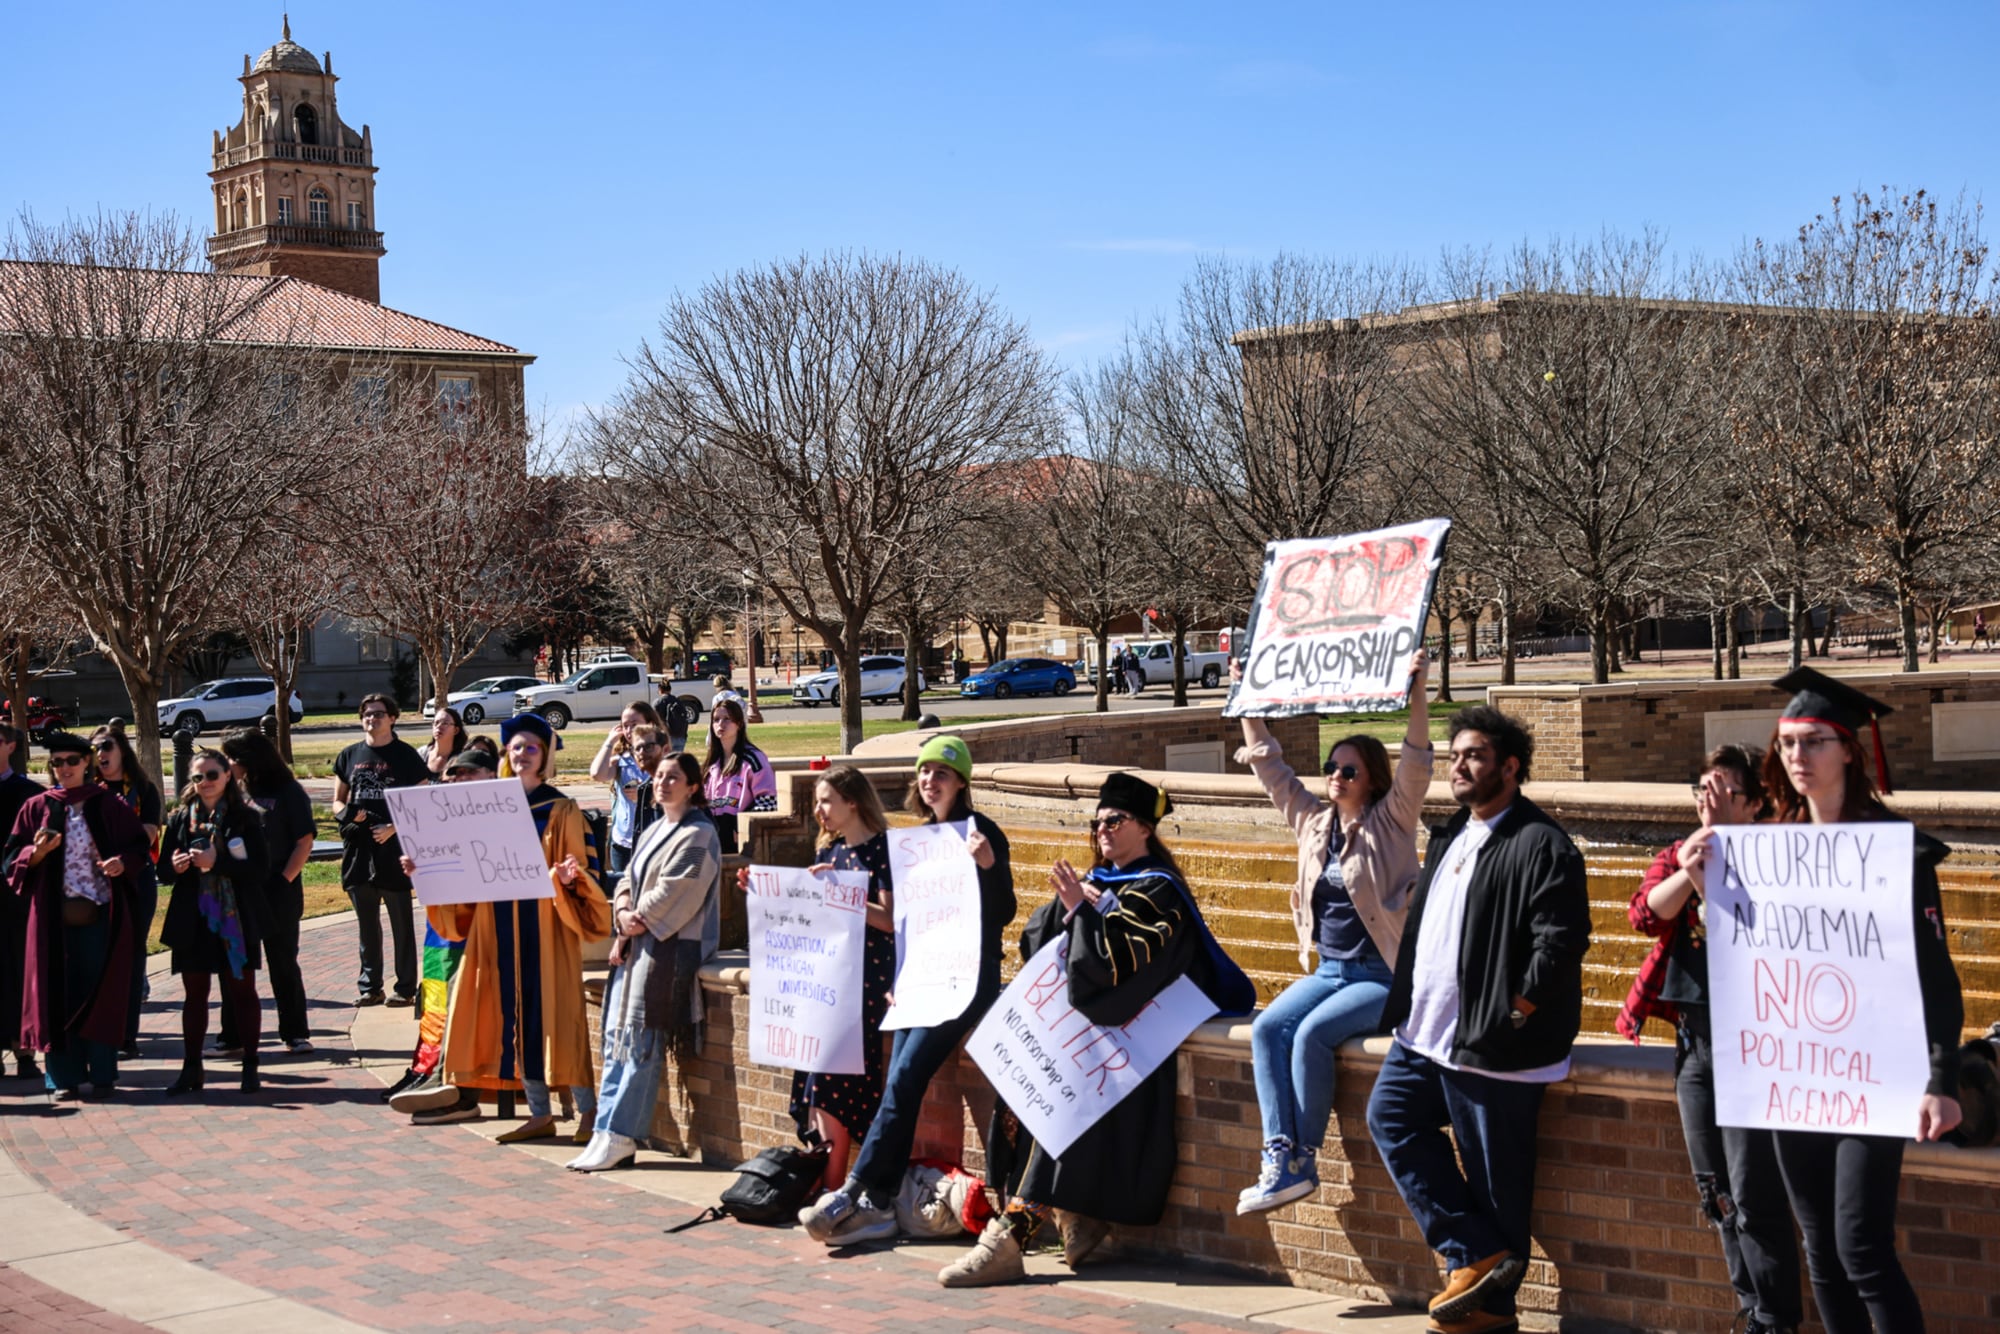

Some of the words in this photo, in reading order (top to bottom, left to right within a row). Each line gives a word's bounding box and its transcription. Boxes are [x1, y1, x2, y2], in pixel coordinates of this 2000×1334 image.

[1277, 537, 1418, 623] STOP
[1250, 626, 1415, 690] CENSORSHIP
[1291, 687, 1307, 697] AT
[1319, 681, 1351, 695] TTU
[388, 793, 419, 832] My
[430, 790, 518, 822] Students
[401, 835, 462, 861] Deserve
[470, 840, 542, 883] Better
[1722, 830, 1875, 892] ACCURACY
[754, 872, 780, 897] TTU
[902, 873, 966, 903] DESERVE
[764, 909, 775, 921] to
[1732, 901, 1884, 961] ACADEMIA
[764, 929, 826, 954] ASSOCIATION
[766, 954, 814, 976] AMERICAN
[764, 997, 780, 1016] LET
[783, 1004, 796, 1018] ME
[779, 979, 836, 1007] UNIVERSITIES
[1754, 958, 1857, 1034] NO
[765, 1024, 797, 1059] TEACH
[800, 1035, 820, 1064] IT!
[993, 1042, 1013, 1075] my
[1741, 1030, 1881, 1085] POLITICAL
[1061, 1085, 1077, 1103] on
[1766, 1081, 1868, 1127] AGENDA
